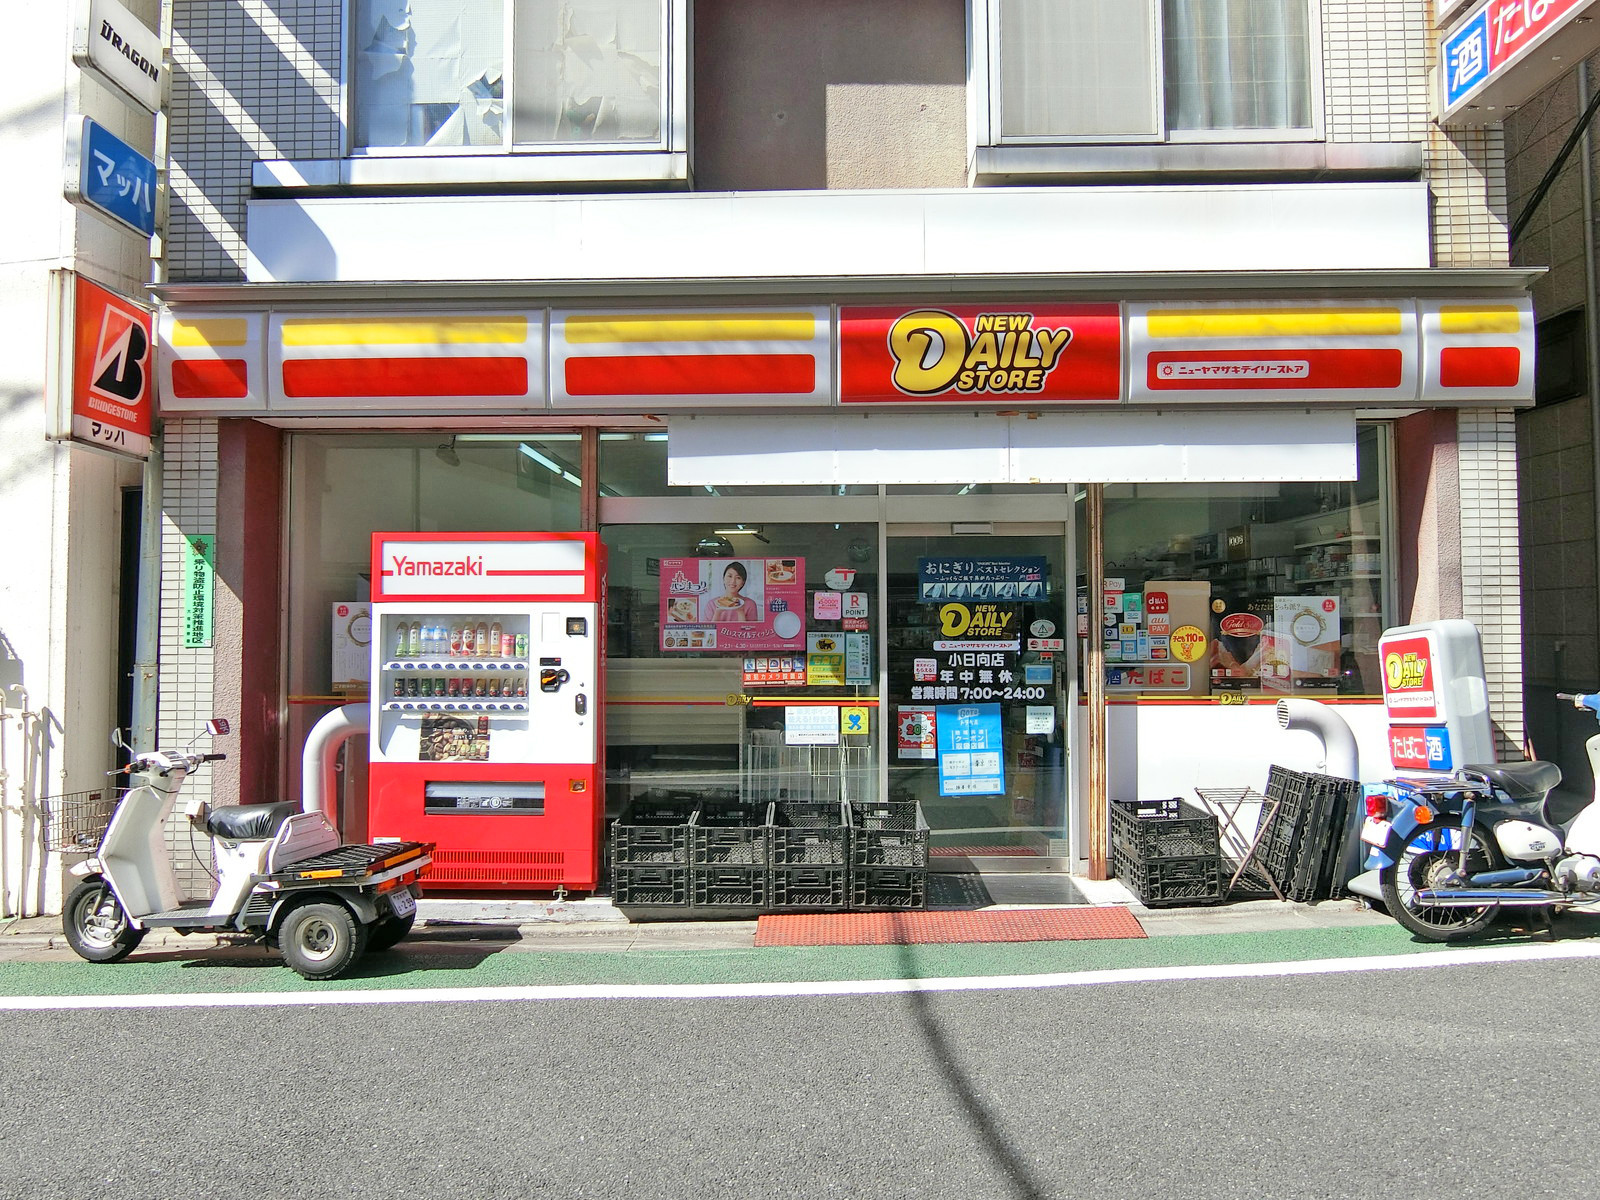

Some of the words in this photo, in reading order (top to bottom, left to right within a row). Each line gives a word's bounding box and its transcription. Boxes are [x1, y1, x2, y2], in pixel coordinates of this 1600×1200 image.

[100, 19, 159, 83] DRAGON
[1450, 27, 1482, 92] 酒
[93, 149, 151, 213] マッハ
[977, 314, 1030, 333] NEW
[890, 309, 1071, 393] DAILY
[957, 369, 1044, 390] STORE
[1178, 364, 1304, 375] ニューヤマザキデイリーストア
[88, 396, 138, 423] BRIDGESTONE
[91, 422, 125, 445] マッハ
[392, 556, 483, 576] Yamazaki
[925, 562, 974, 574] おにぎり
[976, 565, 1041, 574] ベストセレクション
[939, 603, 1013, 636] DAILY
[967, 628, 1002, 636] STORE
[948, 653, 1004, 667] 小日向店
[1404, 653, 1417, 663] NEW
[1127, 669, 1185, 685] たばこ
[1385, 653, 1427, 689] DAILY
[1402, 677, 1422, 688] STORE
[911, 687, 958, 699] 営業時間
[1391, 735, 1426, 759] たばこ
[1426, 736, 1443, 761] 酒
